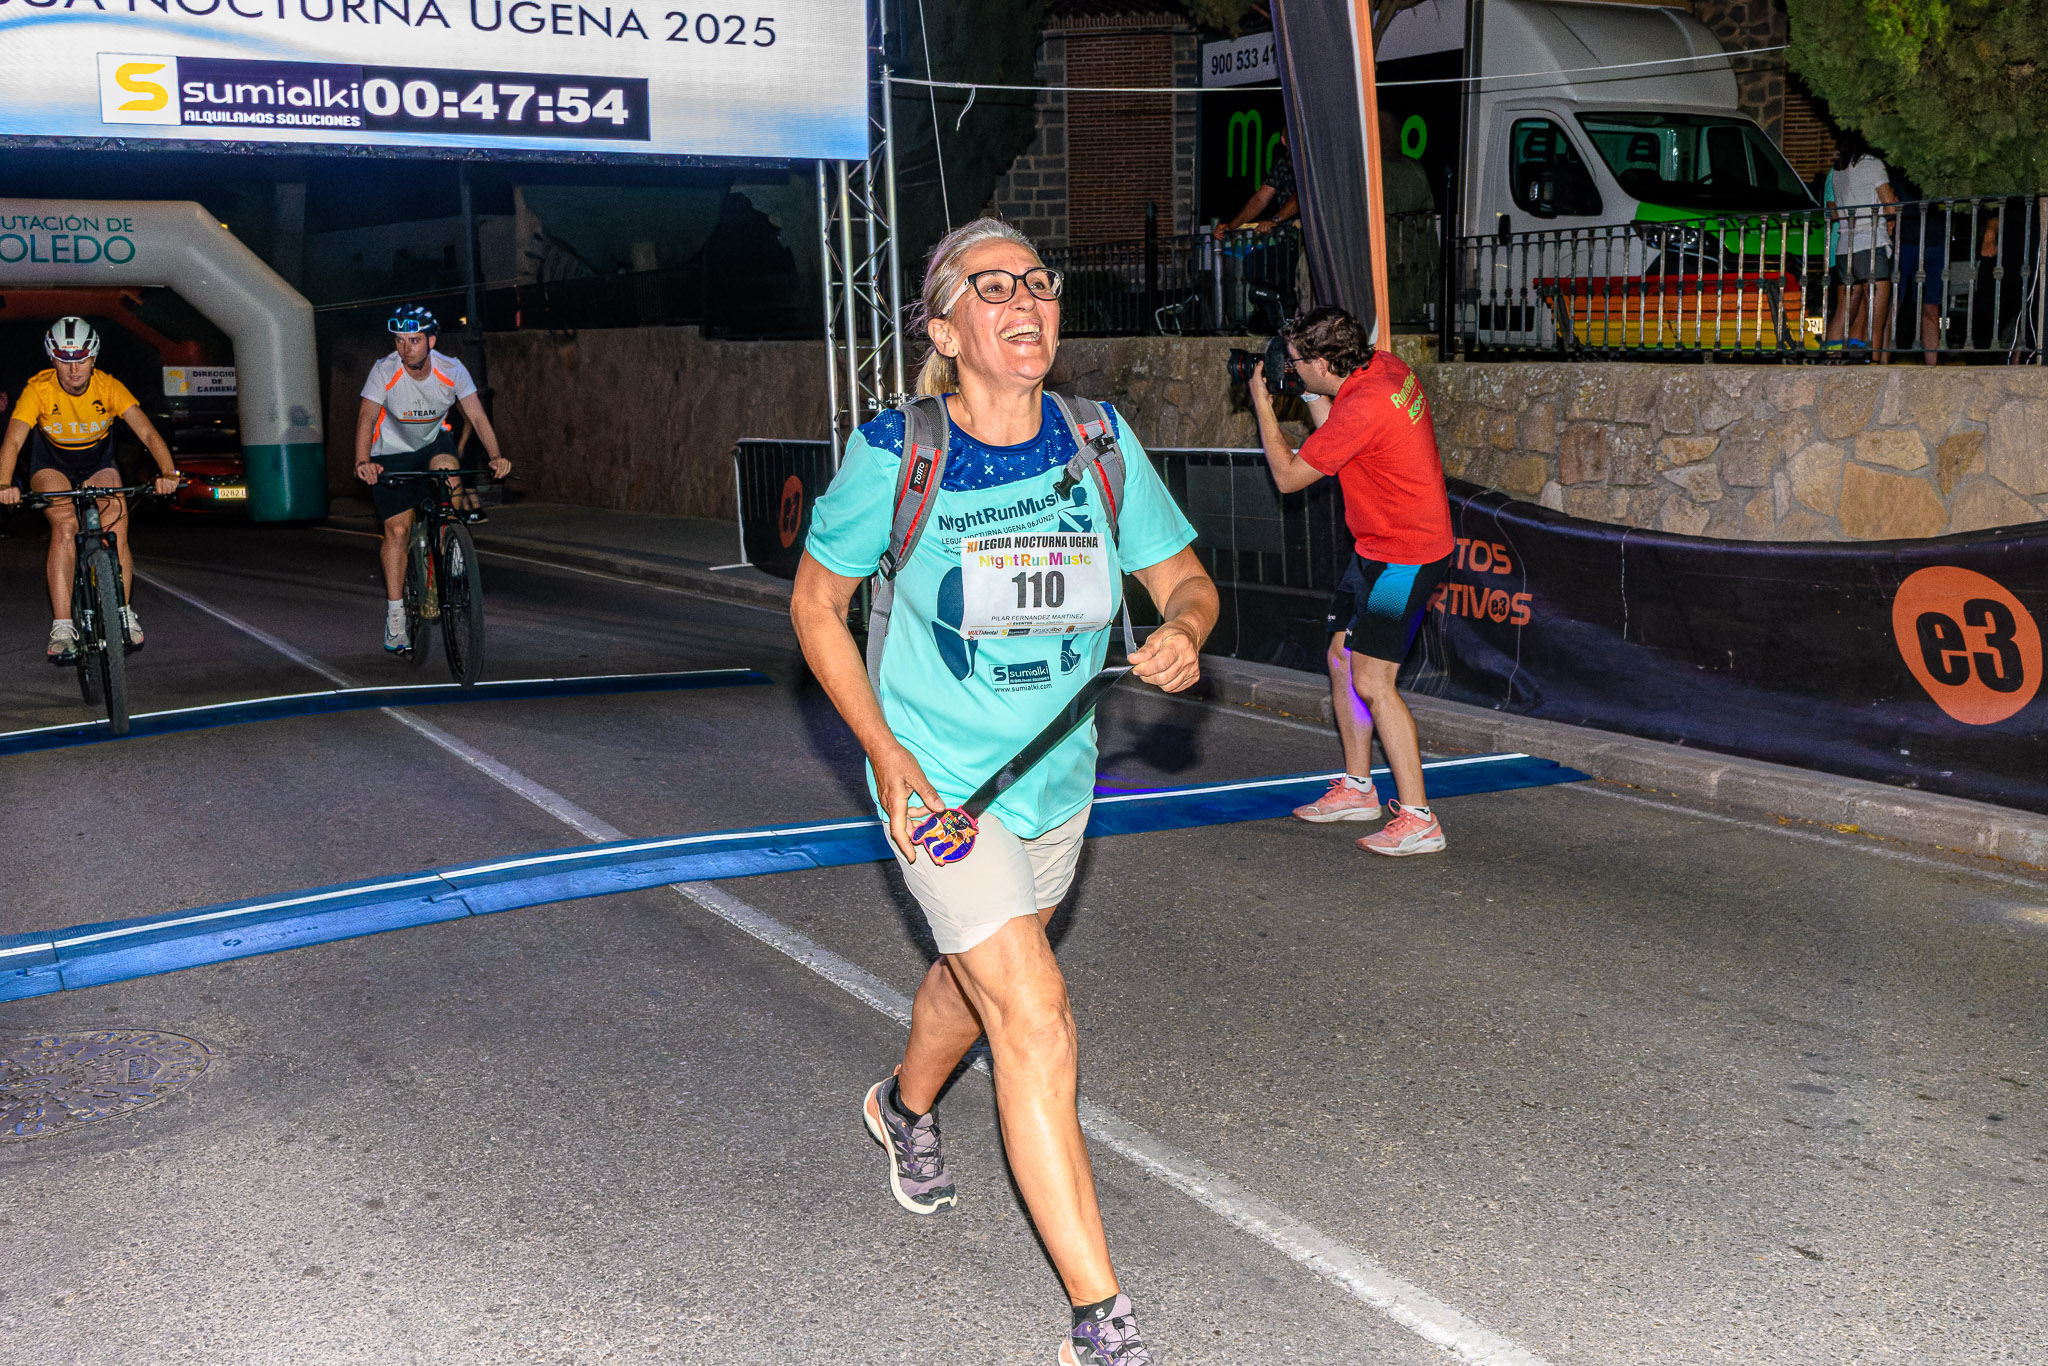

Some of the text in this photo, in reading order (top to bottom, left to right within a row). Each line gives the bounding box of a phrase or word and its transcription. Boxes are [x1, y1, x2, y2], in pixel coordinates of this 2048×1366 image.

[471, 0, 650, 40] UGENA
[665, 11, 777, 47] 2025
[1211, 53, 1233, 76] 900
[1236, 48, 1269, 71] 533
[183, 78, 360, 108] sumialki
[362, 78, 629, 126] 00:47:54
[184, 110, 361, 127] ALQUILAMOS SOLUCIONES
[106, 218, 135, 232] DE
[964, 528, 1002, 539] CTURNA
[1004, 523, 1027, 534] UGENA
[1027, 513, 1055, 528] 06JUN25
[978, 538, 1012, 551] LEGUA
[1014, 536, 1067, 548] NOCTURNA
[1069, 536, 1099, 548] UGENA
[1449, 537, 1512, 575] TOS
[1011, 570, 1065, 609] 110
[1916, 598, 2024, 693] e3
[1009, 665, 1049, 678] sumialki
[994, 683, 1053, 693] www.sumialki.com
